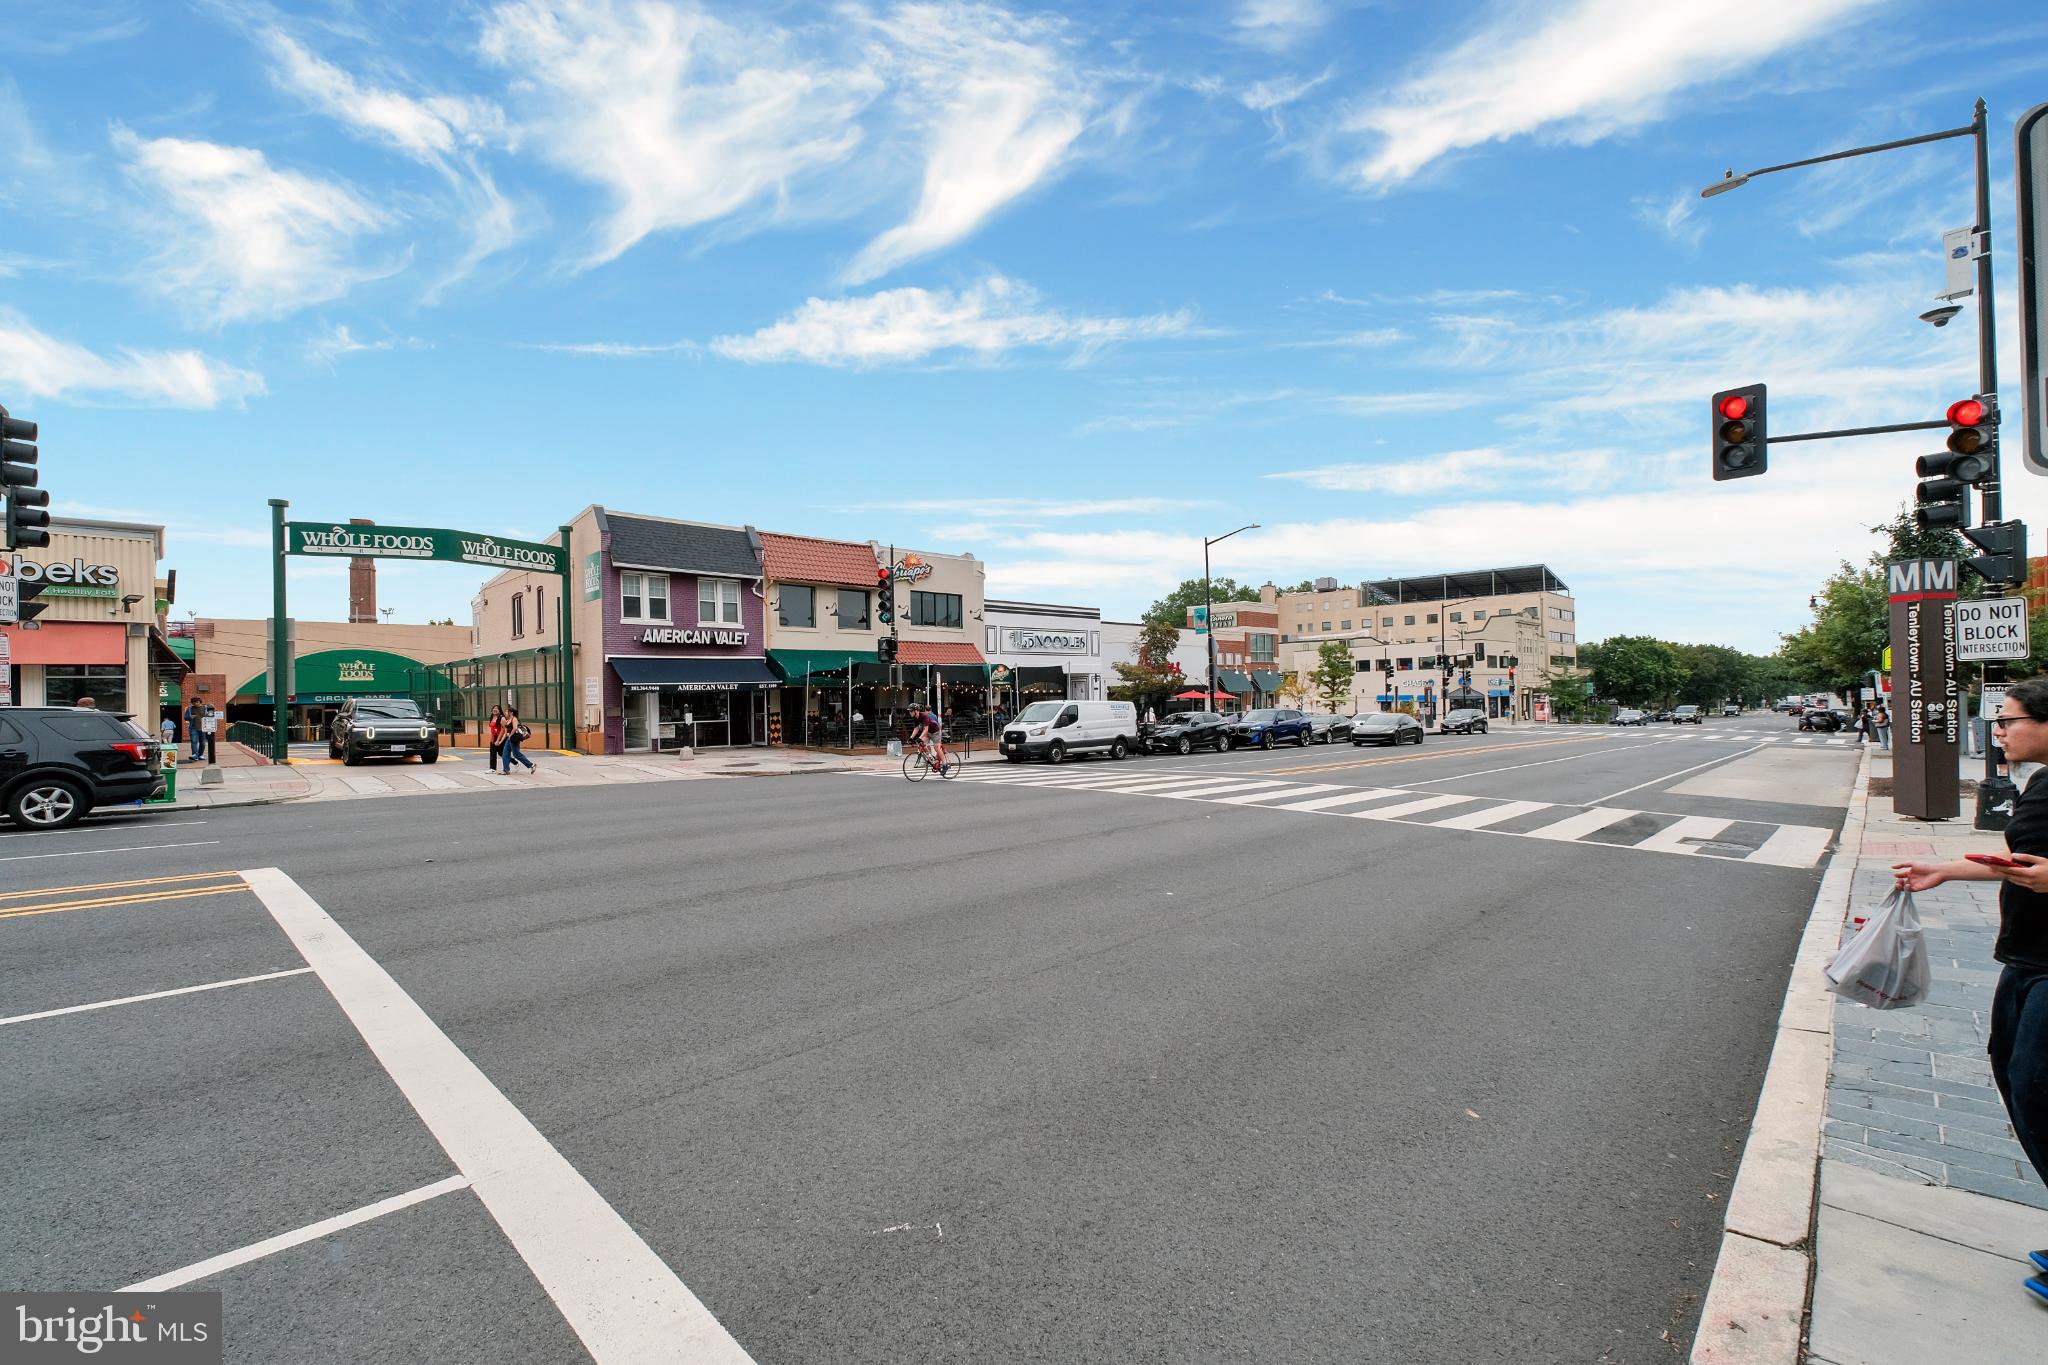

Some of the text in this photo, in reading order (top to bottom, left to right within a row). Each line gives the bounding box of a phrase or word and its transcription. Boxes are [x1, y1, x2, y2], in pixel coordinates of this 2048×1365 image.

[301, 526, 434, 550] WHOLE FOODS
[462, 538, 555, 565] WHOLE FOODS
[893, 560, 931, 580] Guapo's
[1889, 561, 1919, 593] M
[1924, 560, 1953, 590] M
[53, 588, 92, 596] Healthy
[0, 596, 14, 606] CK
[1960, 604, 2021, 621] DO NOT
[643, 628, 749, 645] AMERICAN VALET
[1964, 625, 2018, 640] BLOCK
[1034, 635, 1086, 648] NOODLES
[1960, 642, 2025, 653] INTERSECTION
[338, 659, 376, 670] WHOLE
[1402, 679, 1425, 687] CHASE
[1911, 699, 1923, 742] Station
[1946, 699, 1958, 742] Station
